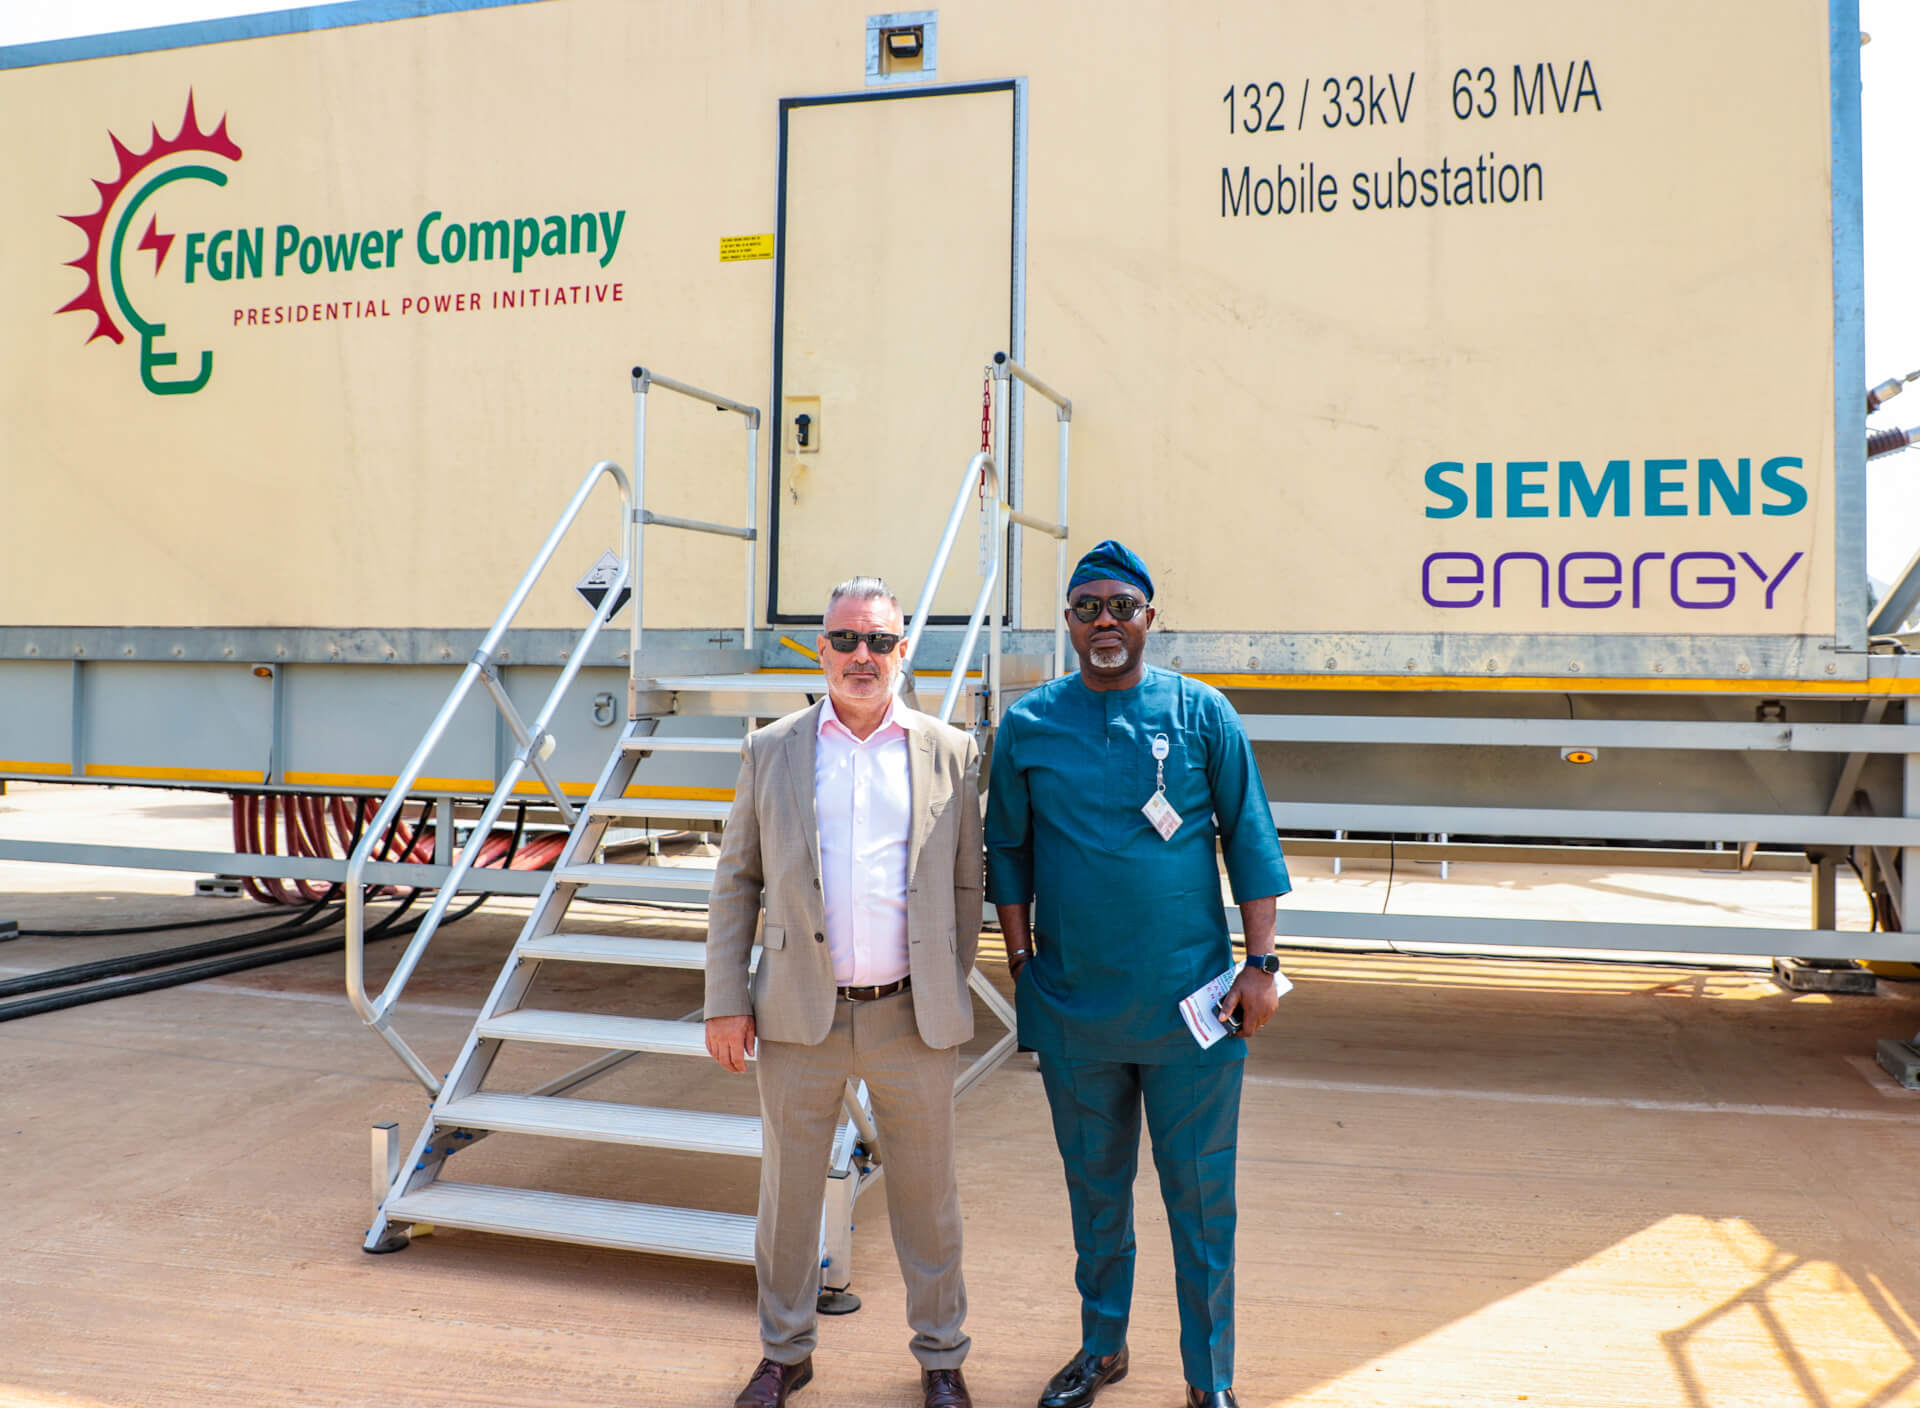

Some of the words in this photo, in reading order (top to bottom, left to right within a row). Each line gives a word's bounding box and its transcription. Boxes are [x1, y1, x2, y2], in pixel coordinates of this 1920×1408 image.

[1222, 83, 1285, 134] 132
[1298, 78, 1310, 131] /
[1323, 72, 1415, 128] 33kV
[1452, 67, 1497, 120] 63
[1513, 60, 1602, 116] MVA
[1222, 162, 1338, 217] Mobile
[1352, 152, 1542, 211] substation
[185, 227, 264, 283] FGN
[275, 225, 403, 276] Power
[417, 210, 626, 272] Company
[234, 300, 390, 325] PRESIDENTIAL
[402, 293, 480, 315] POWER
[492, 283, 623, 309] INITIATIVE
[1424, 456, 1808, 519] SIEMENS
